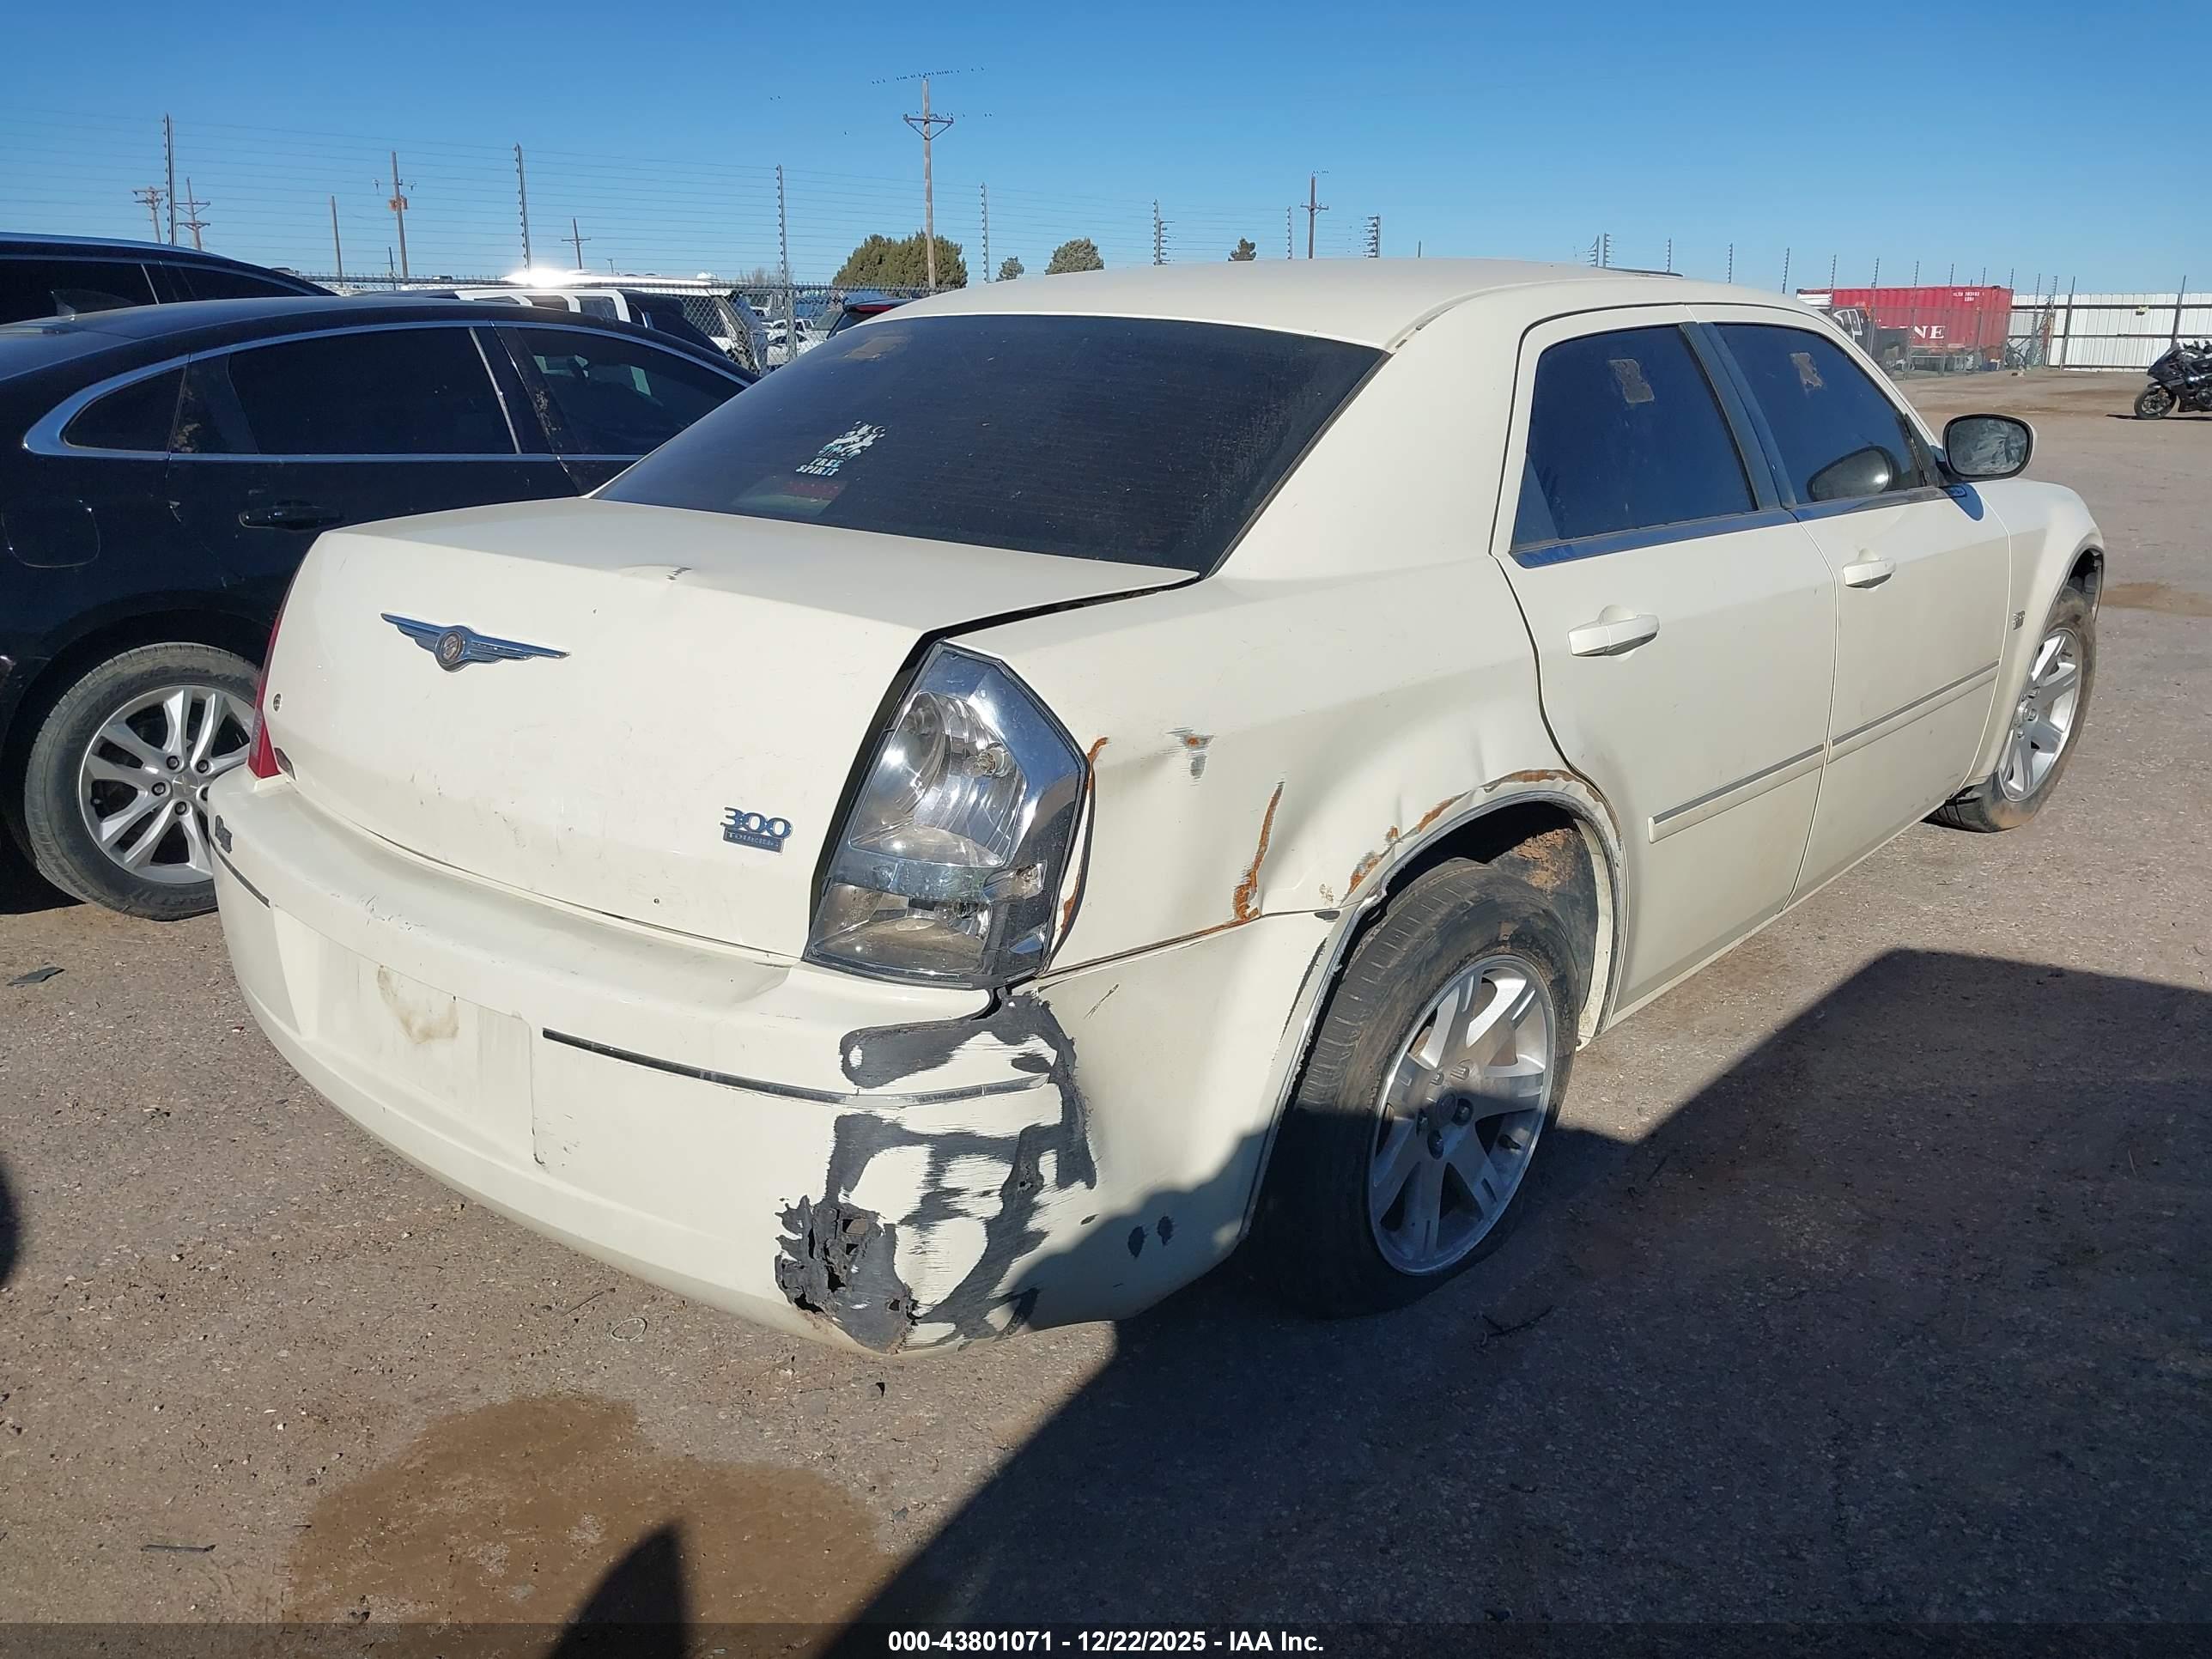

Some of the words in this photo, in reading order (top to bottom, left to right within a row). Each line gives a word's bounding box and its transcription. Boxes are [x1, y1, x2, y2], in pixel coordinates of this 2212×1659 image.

[810, 458, 844, 467] FREE
[795, 465, 839, 476] SPIRIT
[720, 806, 793, 839] 300
